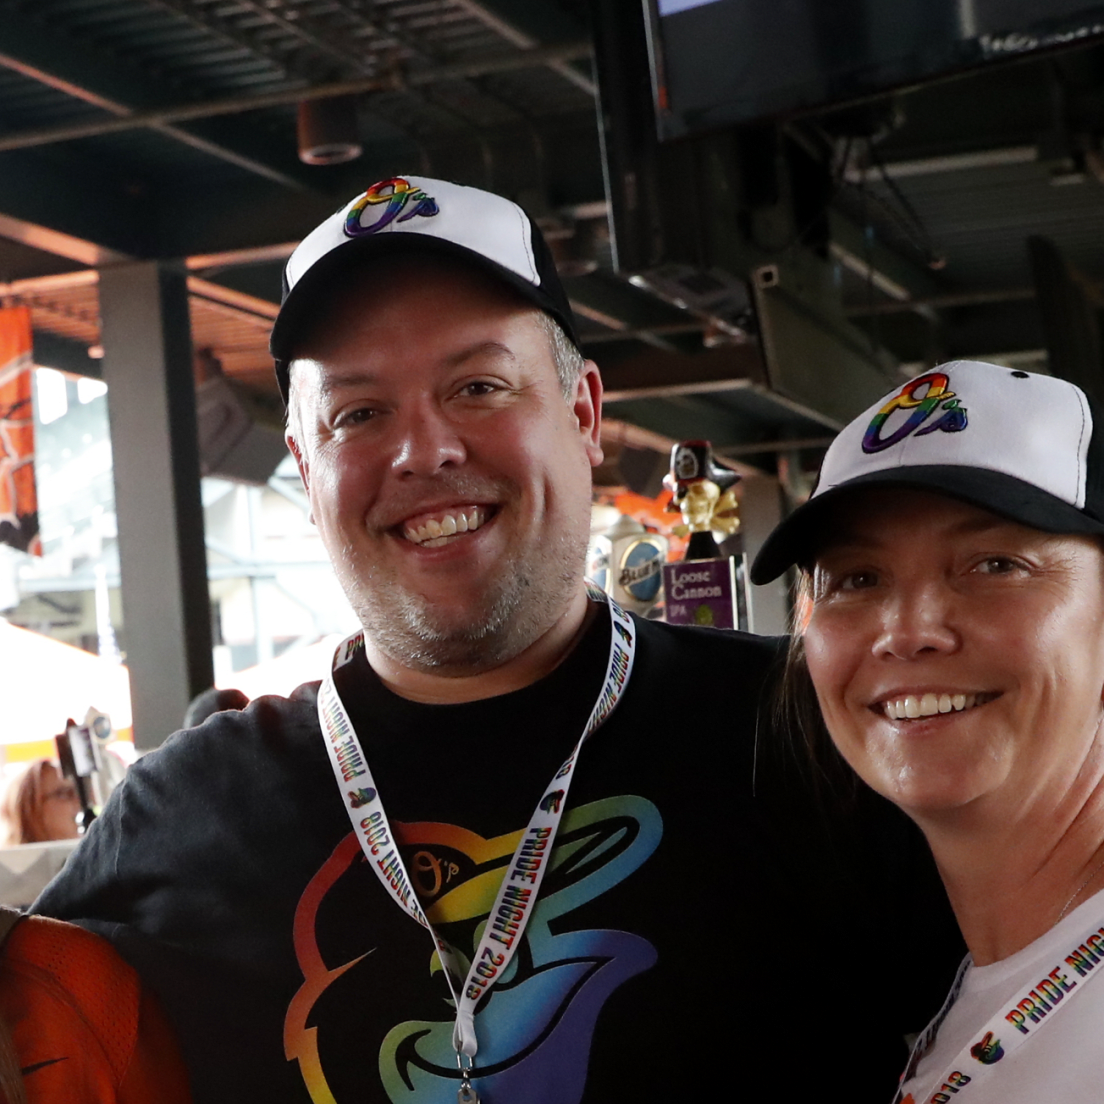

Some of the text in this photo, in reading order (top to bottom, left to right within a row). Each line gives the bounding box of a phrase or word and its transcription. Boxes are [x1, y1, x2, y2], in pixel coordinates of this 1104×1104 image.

[343, 177, 440, 237] O's
[861, 372, 968, 454] O's
[670, 569, 711, 585] Loose
[671, 584, 722, 600] Cannon
[609, 642, 629, 694] PRIDE
[333, 733, 366, 782] PRIDE
[360, 811, 411, 906] NIGHT 2018
[465, 826, 553, 1000] PRIDE NIGHT 2018
[1004, 926, 1104, 1035] PRIDE NIG
